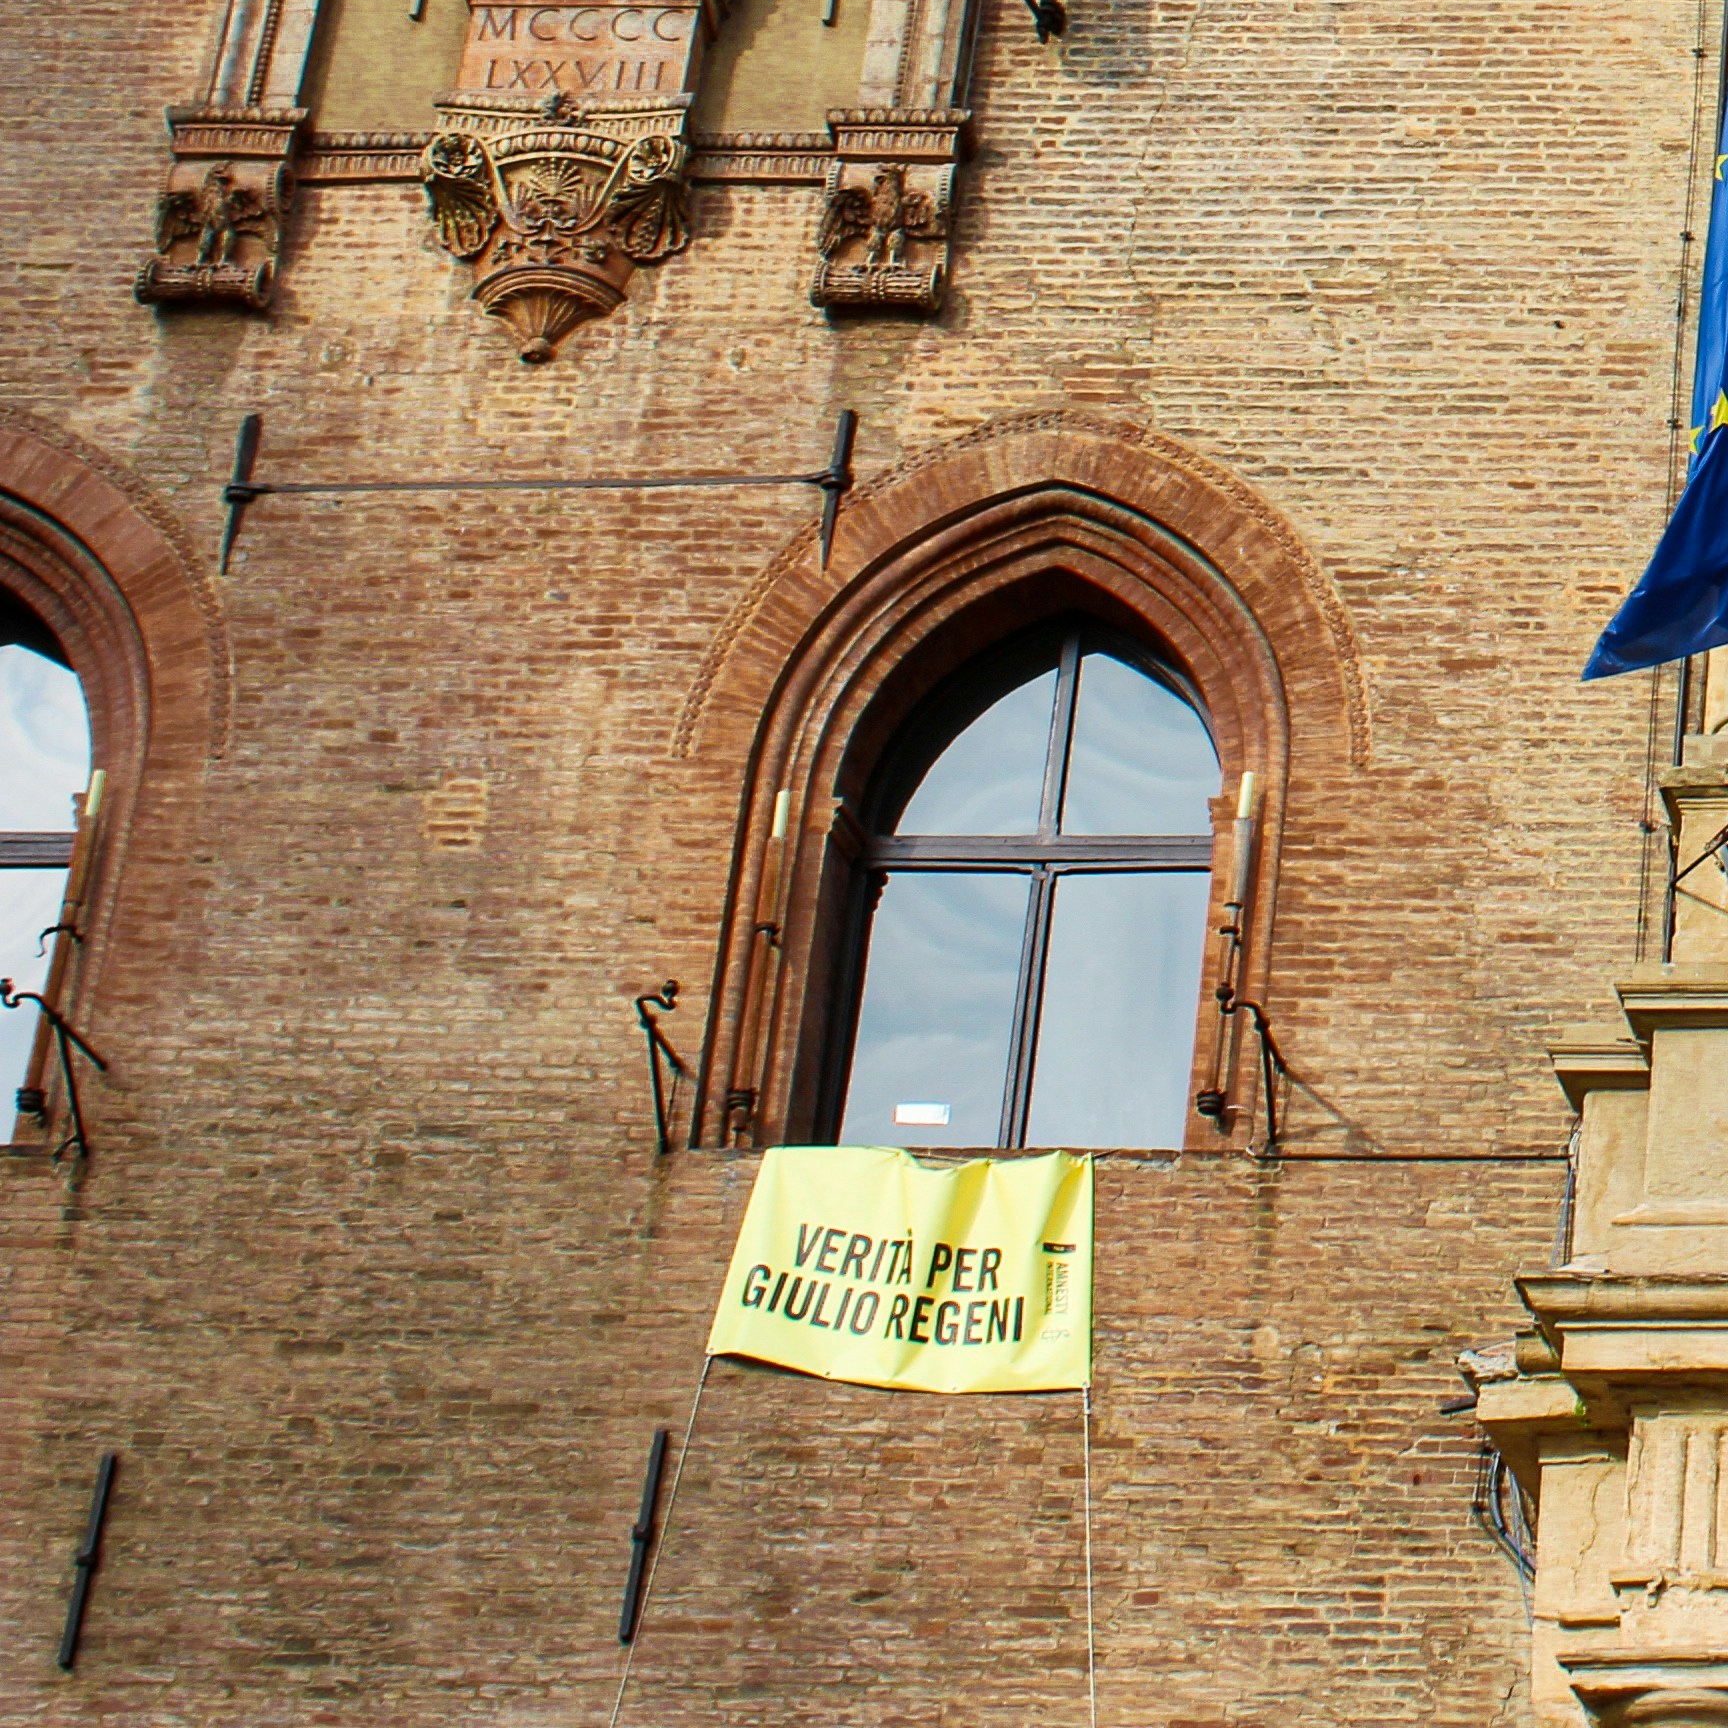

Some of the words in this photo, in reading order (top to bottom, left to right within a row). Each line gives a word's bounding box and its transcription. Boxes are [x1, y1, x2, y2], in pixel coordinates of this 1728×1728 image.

[485, 58, 665, 90] LXXVIII
[793, 1223, 915, 1286] VERITÀ
[926, 1242, 1004, 1293] PER
[1055, 1261, 1070, 1314] AMNESTY
[741, 1263, 882, 1336] GIULIO
[884, 1293, 1026, 1347] REGENI
